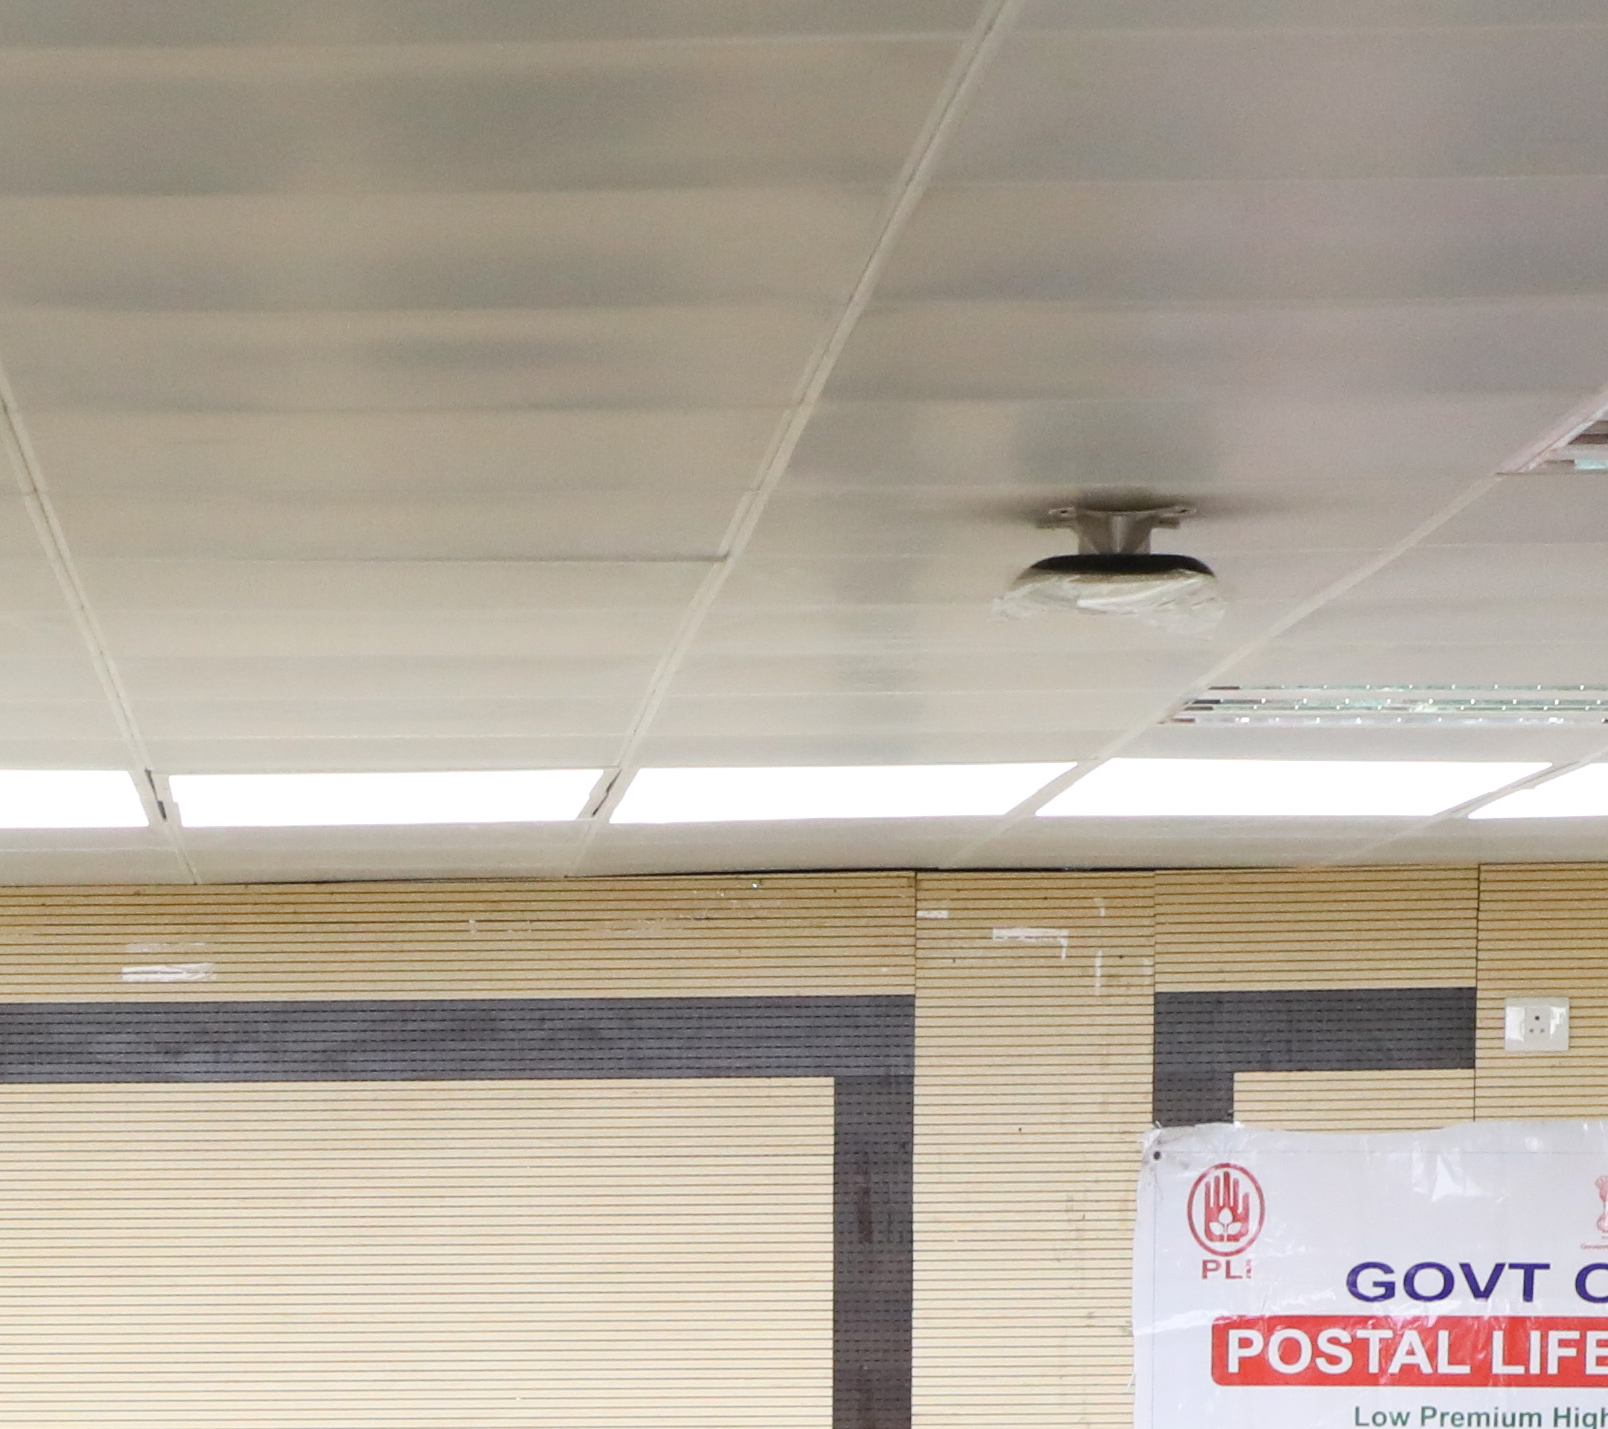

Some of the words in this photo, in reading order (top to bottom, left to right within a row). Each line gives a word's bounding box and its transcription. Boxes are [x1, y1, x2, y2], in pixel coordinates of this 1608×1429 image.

[1346, 1261, 1551, 1303] GOVT
[1227, 1327, 1471, 1375] POSTAL
[1354, 1406, 1411, 1427] Low
[1420, 1406, 1543, 1429] Premium
